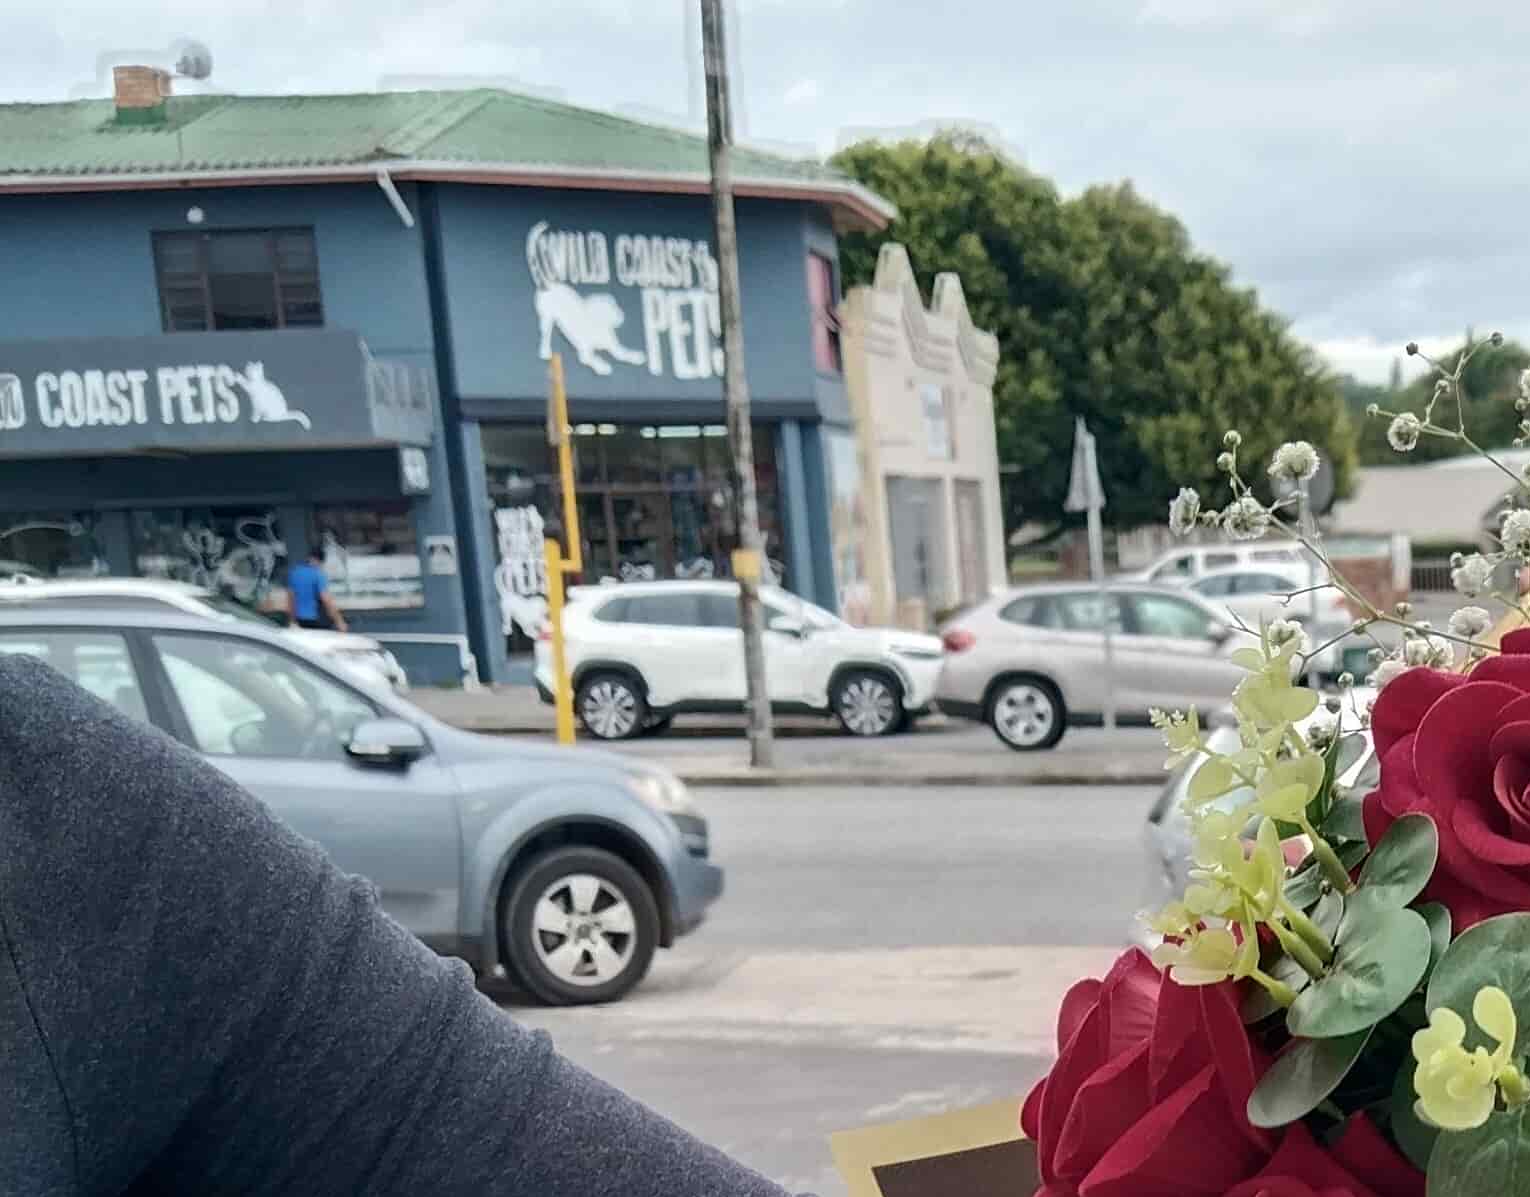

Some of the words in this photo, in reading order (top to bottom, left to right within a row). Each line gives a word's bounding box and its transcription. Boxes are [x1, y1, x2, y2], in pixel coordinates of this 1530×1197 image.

[537, 230, 610, 285] WILD
[614, 233, 693, 288] COAST
[35, 369, 148, 428] COAST
[157, 363, 241, 425] PETS
